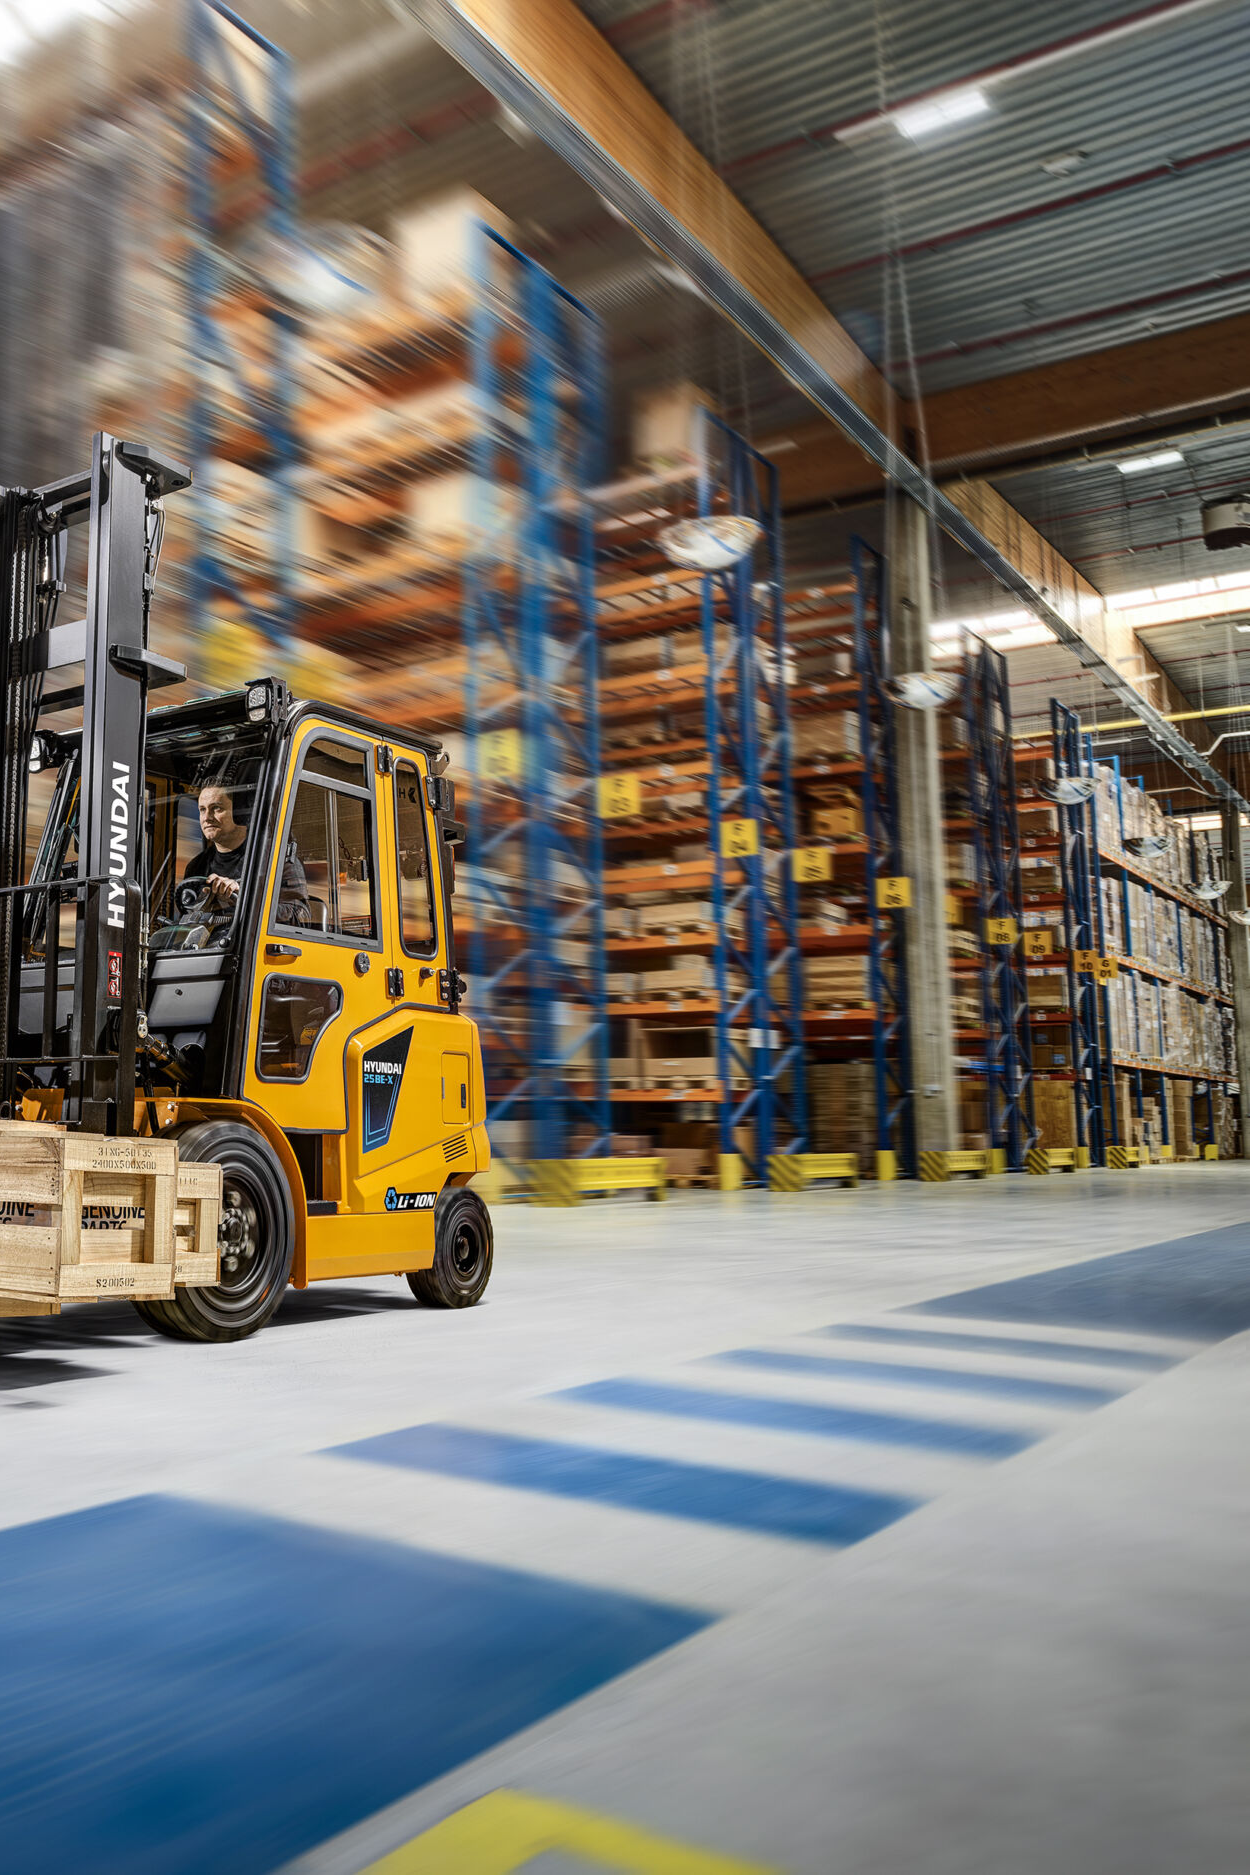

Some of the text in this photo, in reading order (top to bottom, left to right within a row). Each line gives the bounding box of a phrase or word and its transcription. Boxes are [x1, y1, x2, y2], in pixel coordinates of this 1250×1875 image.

[107, 760, 131, 929] HYUNDAI
[1079, 961, 1094, 971] 10
[363, 1060, 402, 1075] HYUNDAI
[363, 1073, 394, 1085] 25BE-X
